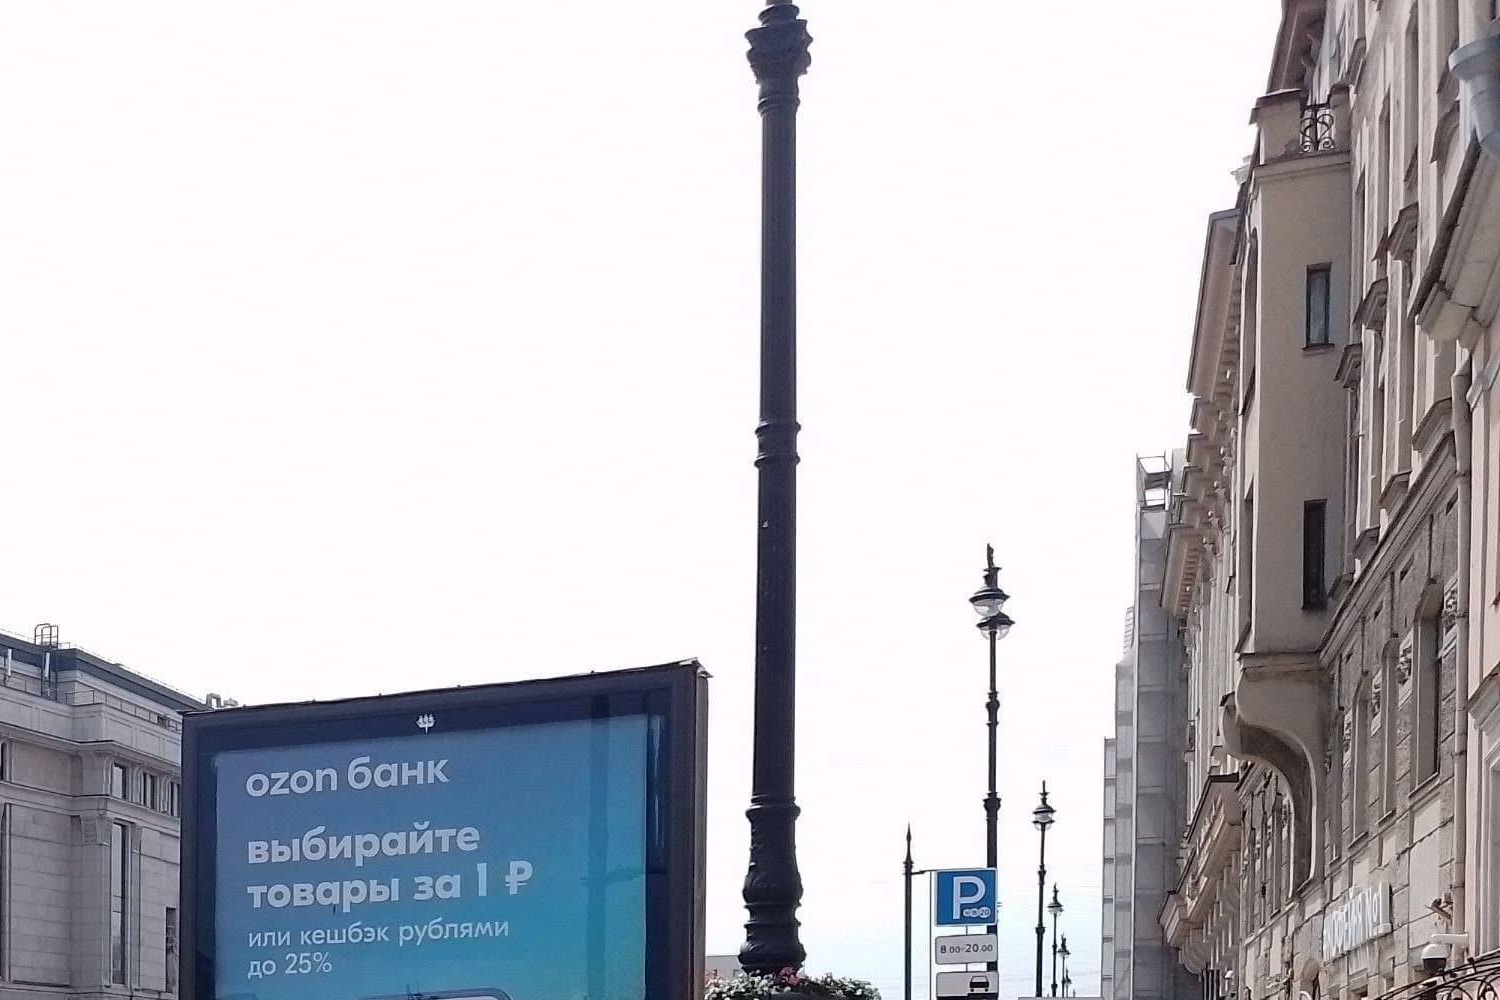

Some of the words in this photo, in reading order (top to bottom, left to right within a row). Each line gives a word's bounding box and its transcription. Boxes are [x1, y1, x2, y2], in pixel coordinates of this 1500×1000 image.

[245, 767, 338, 798] ozon
[347, 756, 450, 791] банк
[248, 820, 480, 867] выбирайте
[247, 875, 400, 913] товары
[413, 872, 461, 900] за
[476, 862, 488, 896] 1
[952, 875, 986, 920] P
[248, 930, 291, 948] или
[300, 922, 389, 946] кешбэк
[398, 917, 509, 948] рублями
[248, 958, 276, 979] до
[285, 951, 333, 975] 25%
